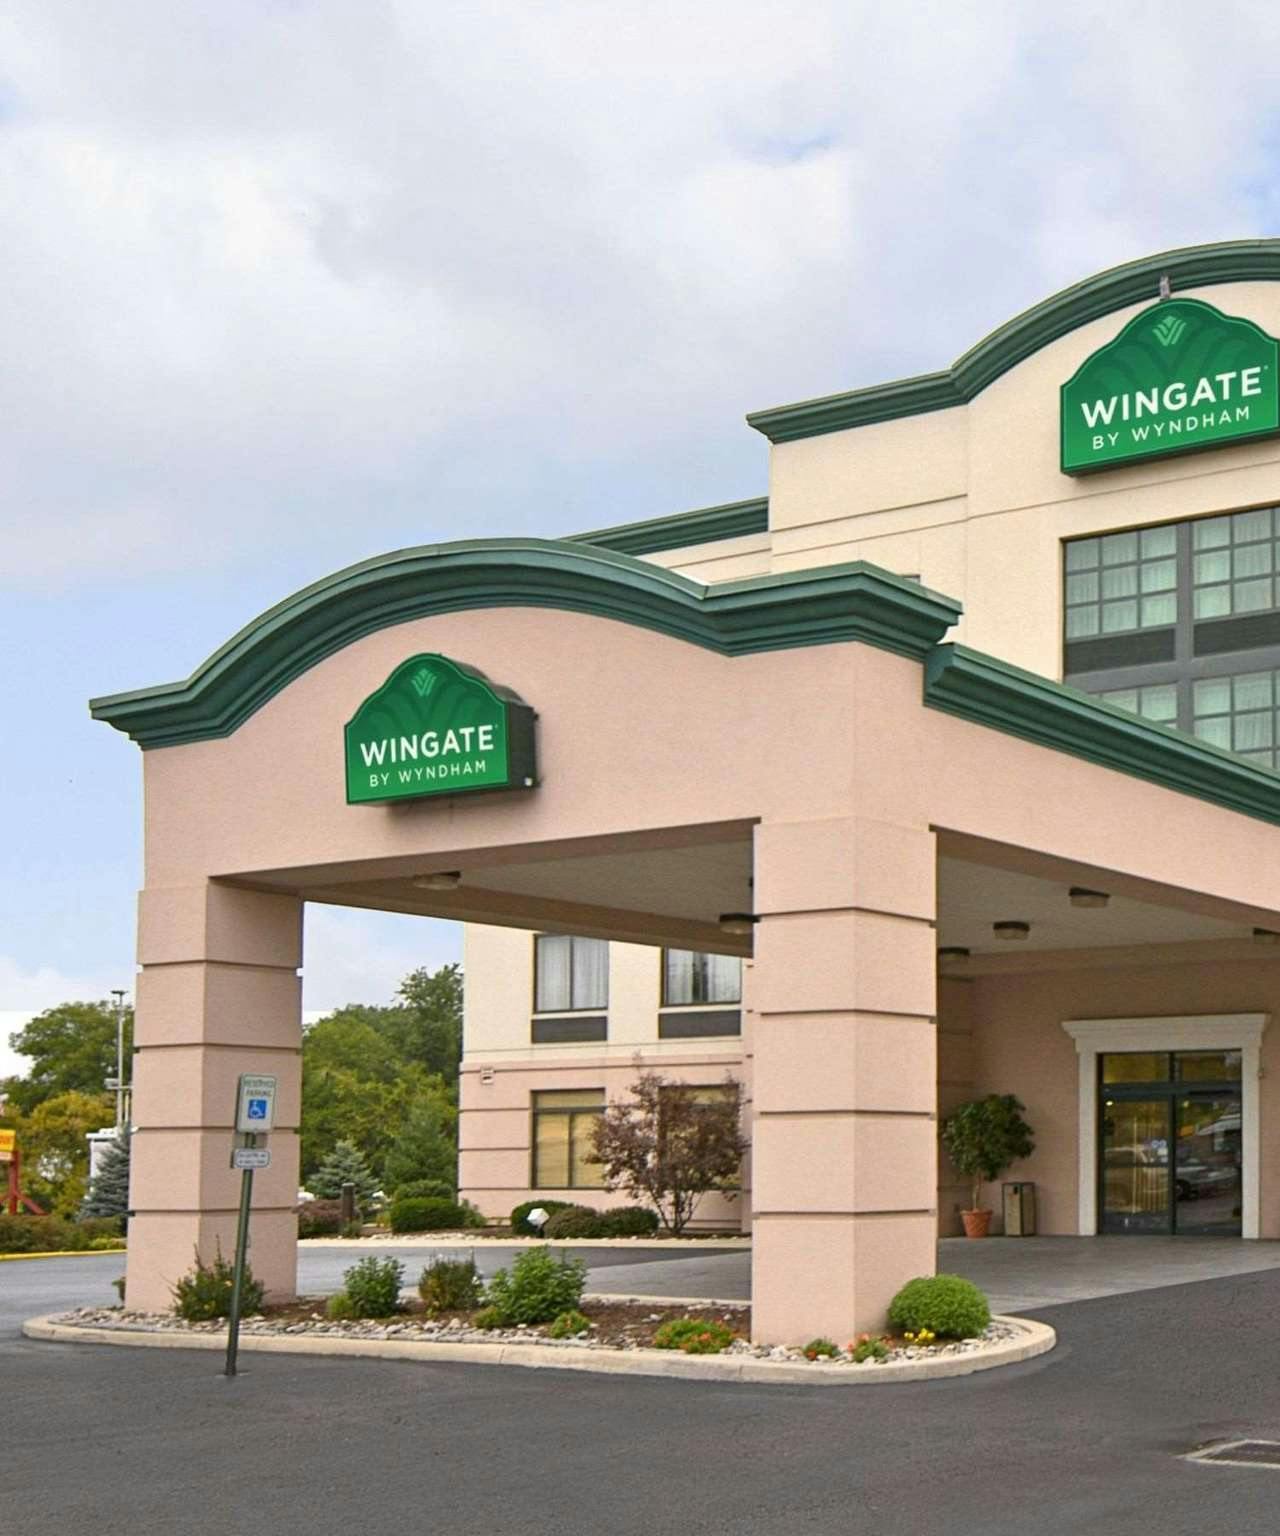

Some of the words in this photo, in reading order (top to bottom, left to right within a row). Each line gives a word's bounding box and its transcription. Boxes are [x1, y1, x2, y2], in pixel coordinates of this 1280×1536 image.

[1081, 366, 1262, 428] WINGATE
[1092, 432, 1119, 450] BY
[1132, 406, 1250, 442] WYNDHAM
[360, 724, 494, 767] WINGATE
[369, 772, 390, 787] BY
[398, 760, 486, 784] WYNDHAM
